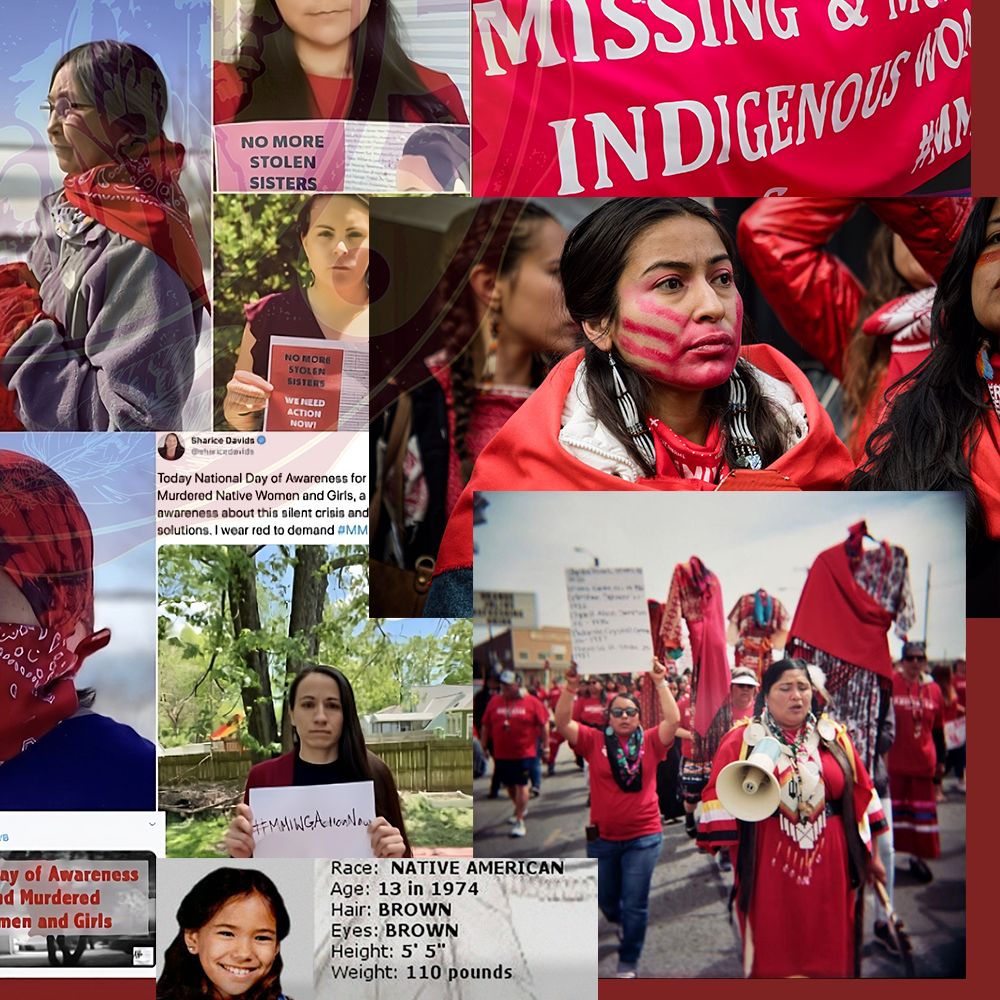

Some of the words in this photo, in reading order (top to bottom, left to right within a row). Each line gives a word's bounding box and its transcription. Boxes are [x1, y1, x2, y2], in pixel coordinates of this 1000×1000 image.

[548, 51, 911, 195] INDIGENOUS
[241, 136, 268, 148] NO
[273, 135, 324, 148] MORE
[250, 156, 316, 169] STOLEN
[250, 177, 317, 190] SISTERS
[287, 408, 321, 418] ACTION
[24, 865, 42, 882] of
[49, 865, 139, 882] Awareness
[332, 861, 378, 874] Race:
[392, 861, 459, 874] NATIVE
[466, 860, 564, 874] AMERICAN
[331, 882, 369, 898] Age:
[379, 882, 401, 895] 13
[408, 881, 423, 895] in
[432, 882, 478, 896] 1974
[20, 889, 100, 905] Murdered
[332, 902, 370, 916] Hair:
[379, 903, 451, 916] BROWN
[38, 913, 68, 928] and
[74, 913, 113, 928] Girls
